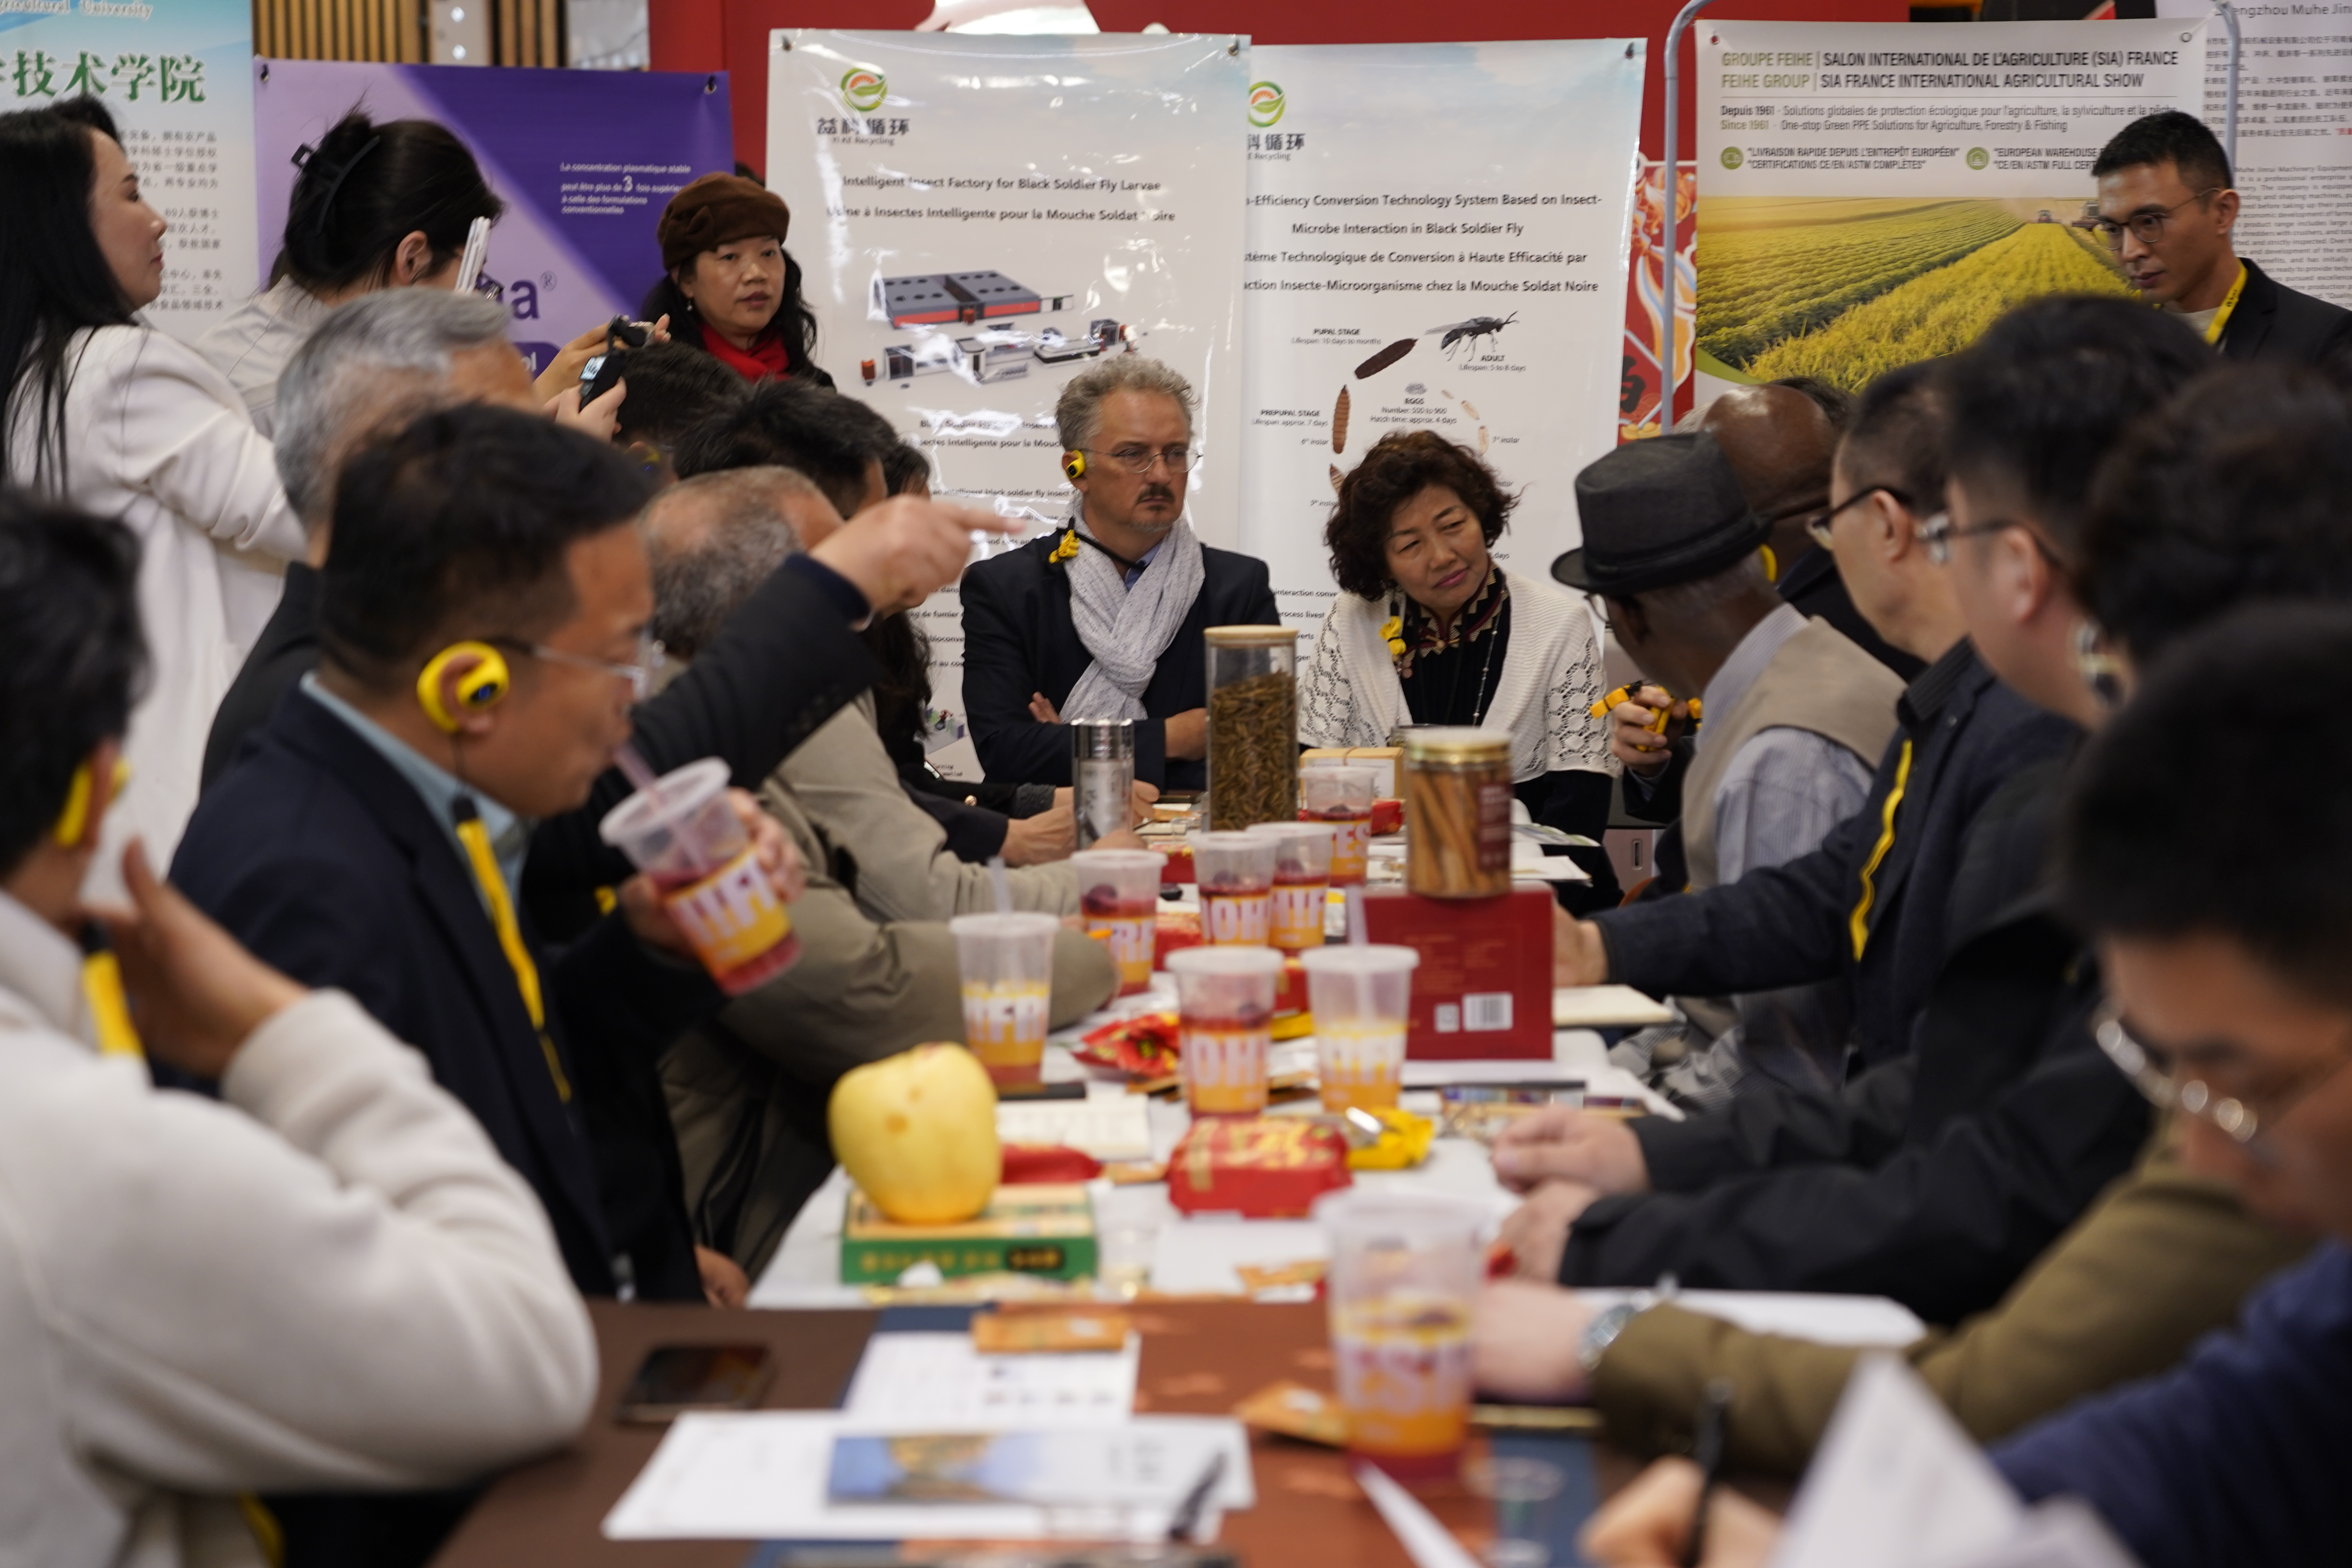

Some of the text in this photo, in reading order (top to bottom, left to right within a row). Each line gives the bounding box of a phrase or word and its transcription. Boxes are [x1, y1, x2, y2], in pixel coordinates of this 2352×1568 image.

[81, 1, 153, 20] University
[2292, 4, 2329, 15] Muhe
[1721, 51, 2178, 68] GROUPE FEIHE SALON INTERNATIONAL DE L'AGRICULTURE (SIA) FRANCE
[0, 49, 207, 103] 技术学院
[1721, 73, 2145, 87] FEIHE GROUP SIA FRANCE INTERNATIONAL AGRICULTURAL SHOW
[1720, 105, 2137, 118] Depuis 1961 Solutions globales de protection écologique pour sylviculture et
[1720, 120, 2068, 132] Since 1961 One-stop Green PPE Solutions for Agriculture, Forestry Fishing
[855, 136, 895, 147] Recycling
[1254, 152, 1291, 161] Recycling
[1797, 148, 1859, 156] RAPIDE DEPUIS
[2045, 148, 2097, 157] WAREHOUSE
[571, 163, 667, 174] concentration plasmatique
[2053, 161, 2072, 169] FULL
[561, 175, 633, 192] peut plus 3
[843, 175, 1161, 193] Intelligent Factory for Black Soldier Fly Larvae
[587, 195, 648, 205] des formulations
[1313, 195, 1378, 206] Conversion
[1382, 194, 1451, 208] Technology
[1455, 194, 1498, 208] System
[1502, 194, 1538, 204] Based
[1542, 196, 1557, 205] on
[1561, 194, 1602, 204] Insect-
[561, 205, 624, 214] conventionnelles
[875, 206, 924, 217] Insectes
[926, 206, 996, 221] Intelligente
[999, 210, 1029, 221] pour
[1032, 209, 1042, 219] la
[1046, 209, 1095, 220] Mouche
[1099, 210, 1138, 221] Soldat
[1292, 223, 1524, 236] Microbe Interaction in Black Soldier Fly
[1281, 251, 1588, 265] Technologique de Conversion Haute Efficacité par
[1280, 279, 1422, 294] Insecte-Microorganisme
[1426, 280, 1453, 291] chez
[1455, 280, 1466, 291] la
[1470, 280, 1519, 291] Mouche
[1522, 280, 1561, 291] Soldat
[1564, 280, 1599, 291] Noire
[1313, 419, 1328, 428] days
[948, 438, 998, 450] Intelligente
[1000, 441, 1022, 450] pour
[1035, 490, 1045, 498] fly
[1494, 552, 1510, 560] days
